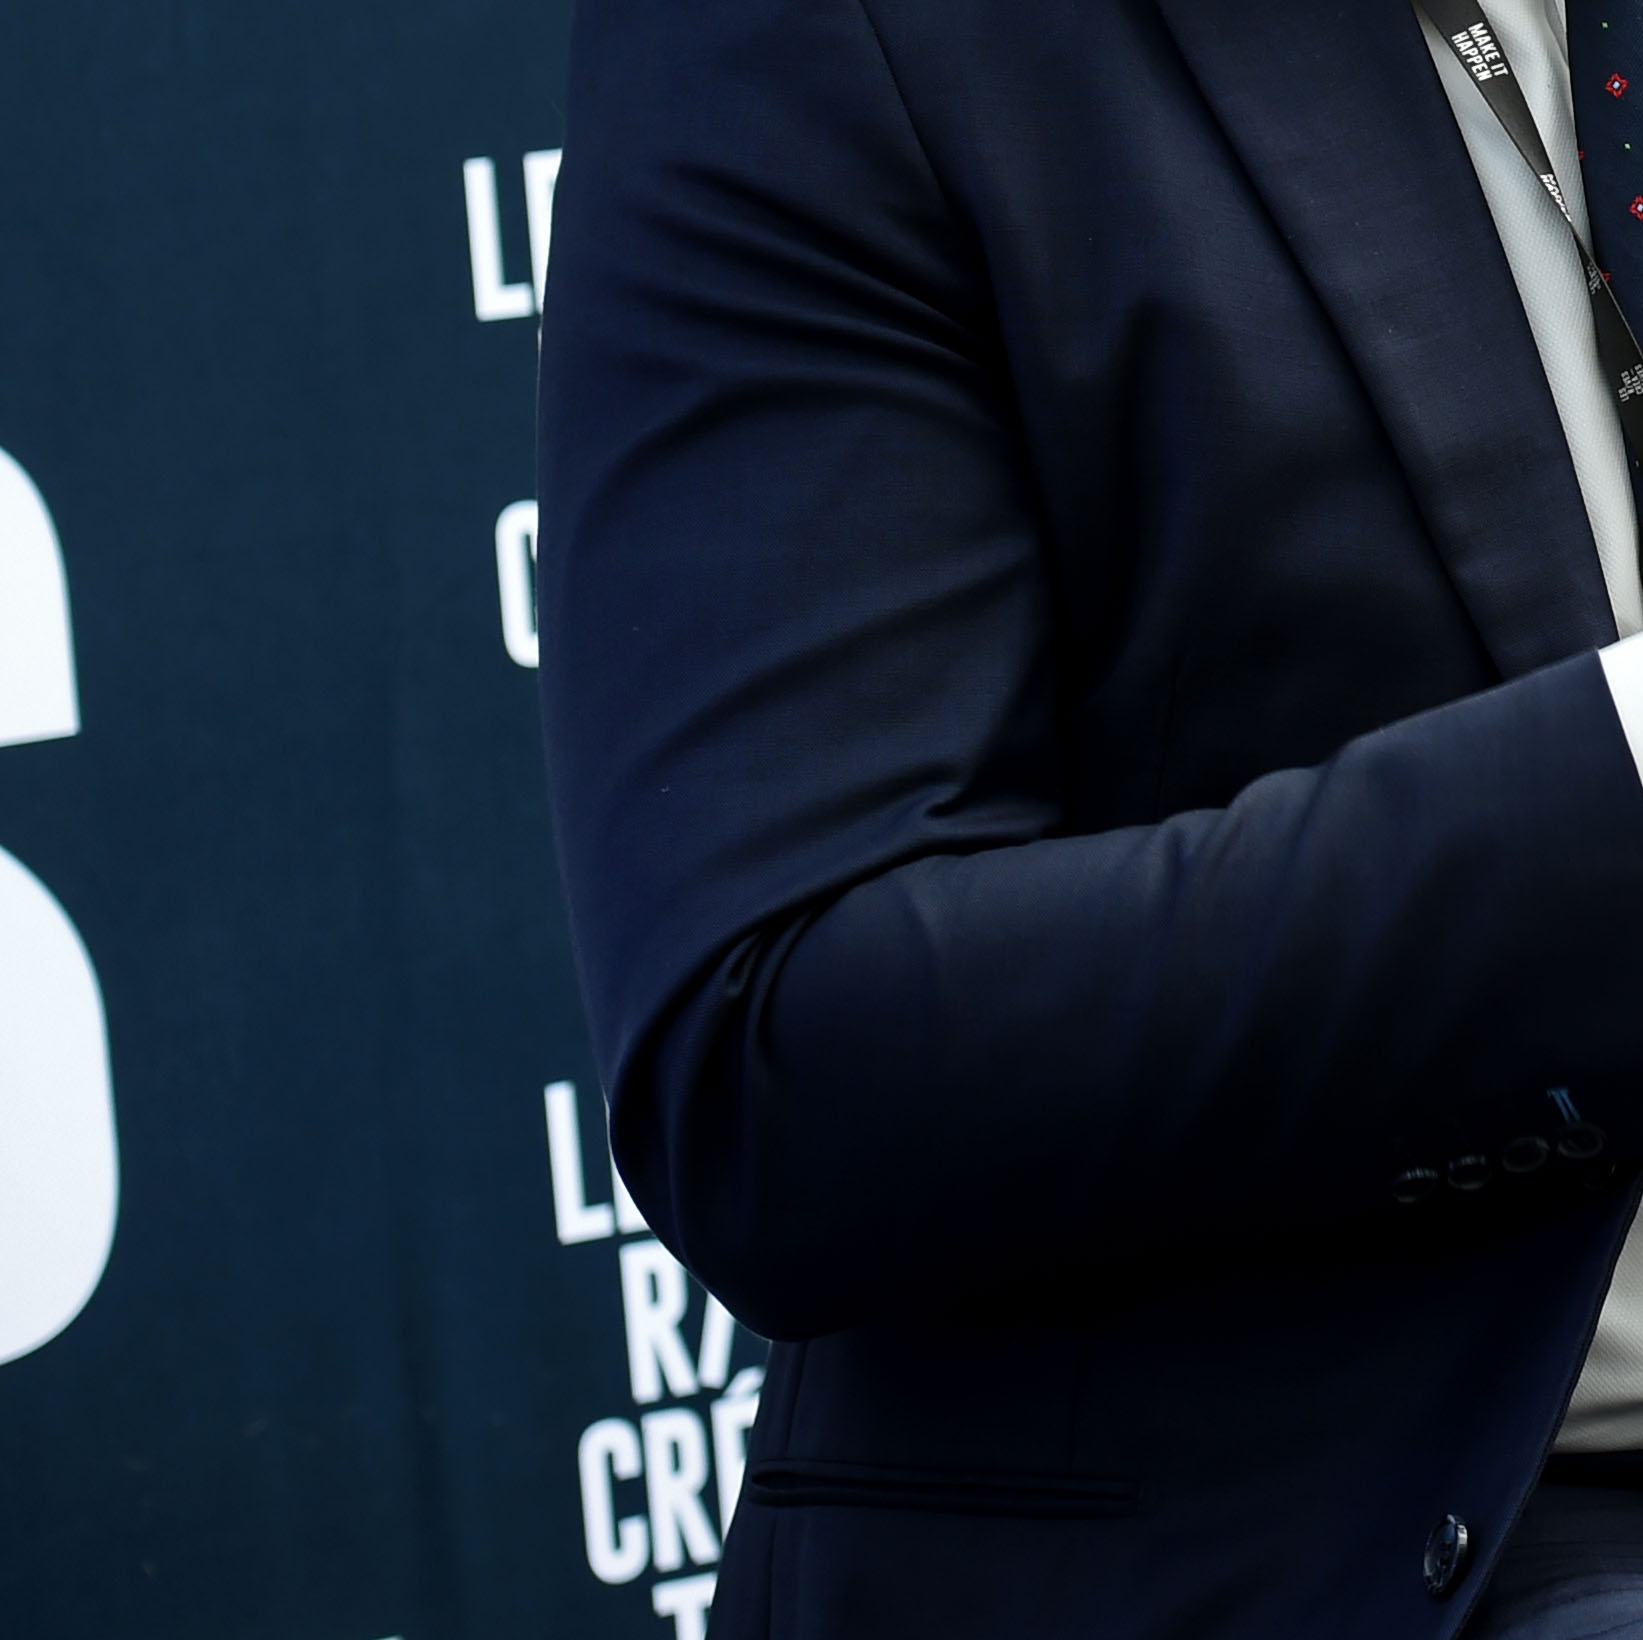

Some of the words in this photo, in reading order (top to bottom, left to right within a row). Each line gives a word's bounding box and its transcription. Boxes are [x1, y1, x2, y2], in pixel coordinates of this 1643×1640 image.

[1451, 31, 1493, 82] HAPPEN
[1468, 22, 1501, 62] MAKE
[1490, 62, 1509, 77] IT
